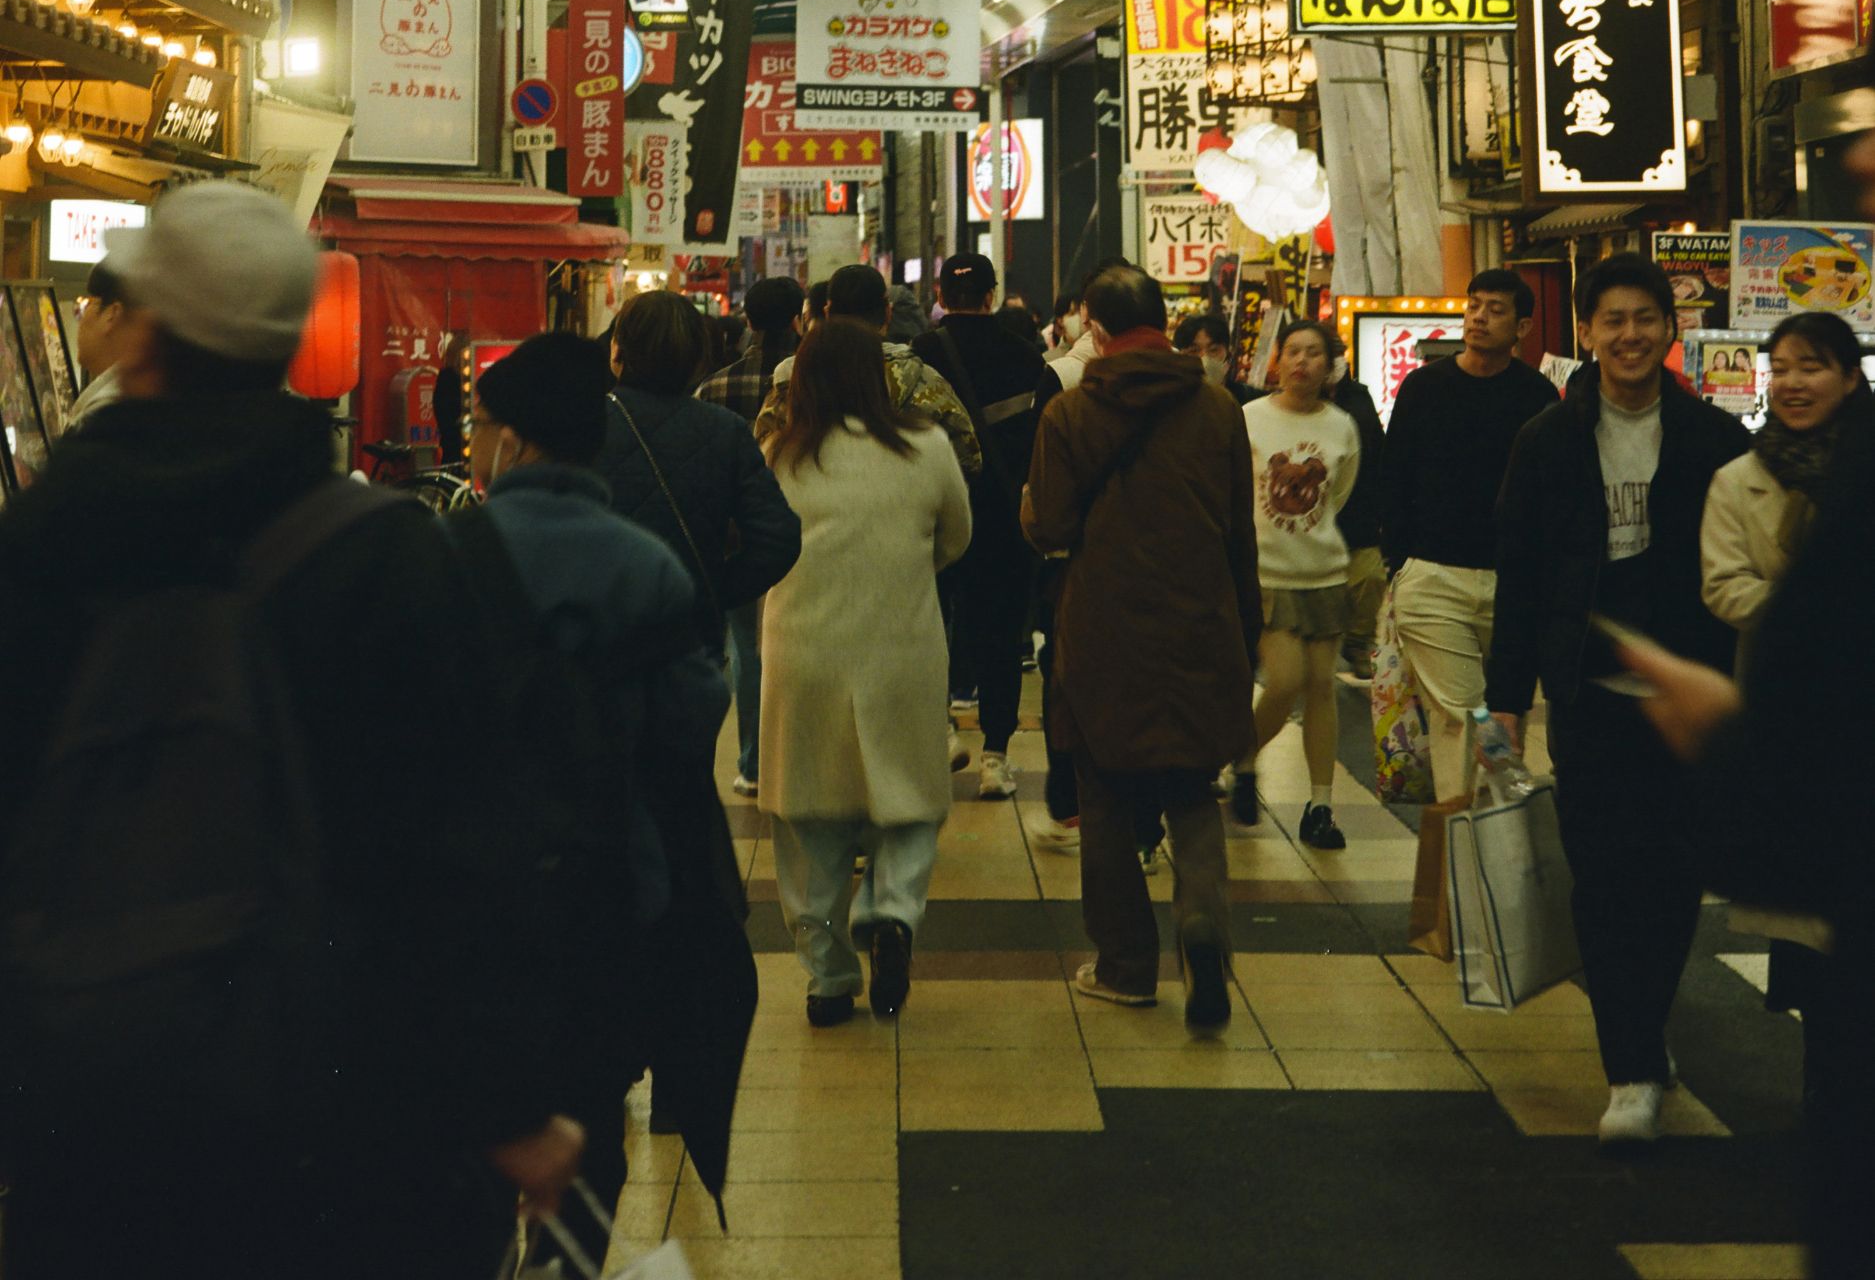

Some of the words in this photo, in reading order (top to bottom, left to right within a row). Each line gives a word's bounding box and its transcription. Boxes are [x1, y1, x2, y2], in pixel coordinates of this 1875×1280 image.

[845, 15, 933, 38] カラオケ
[827, 43, 949, 81] まねきねこ
[802, 89, 946, 109] SWINGヨシモト3F
[515, 129, 554, 147] 自動車
[581, 99, 612, 189] 豚まん
[67, 211, 97, 249] TAKE
